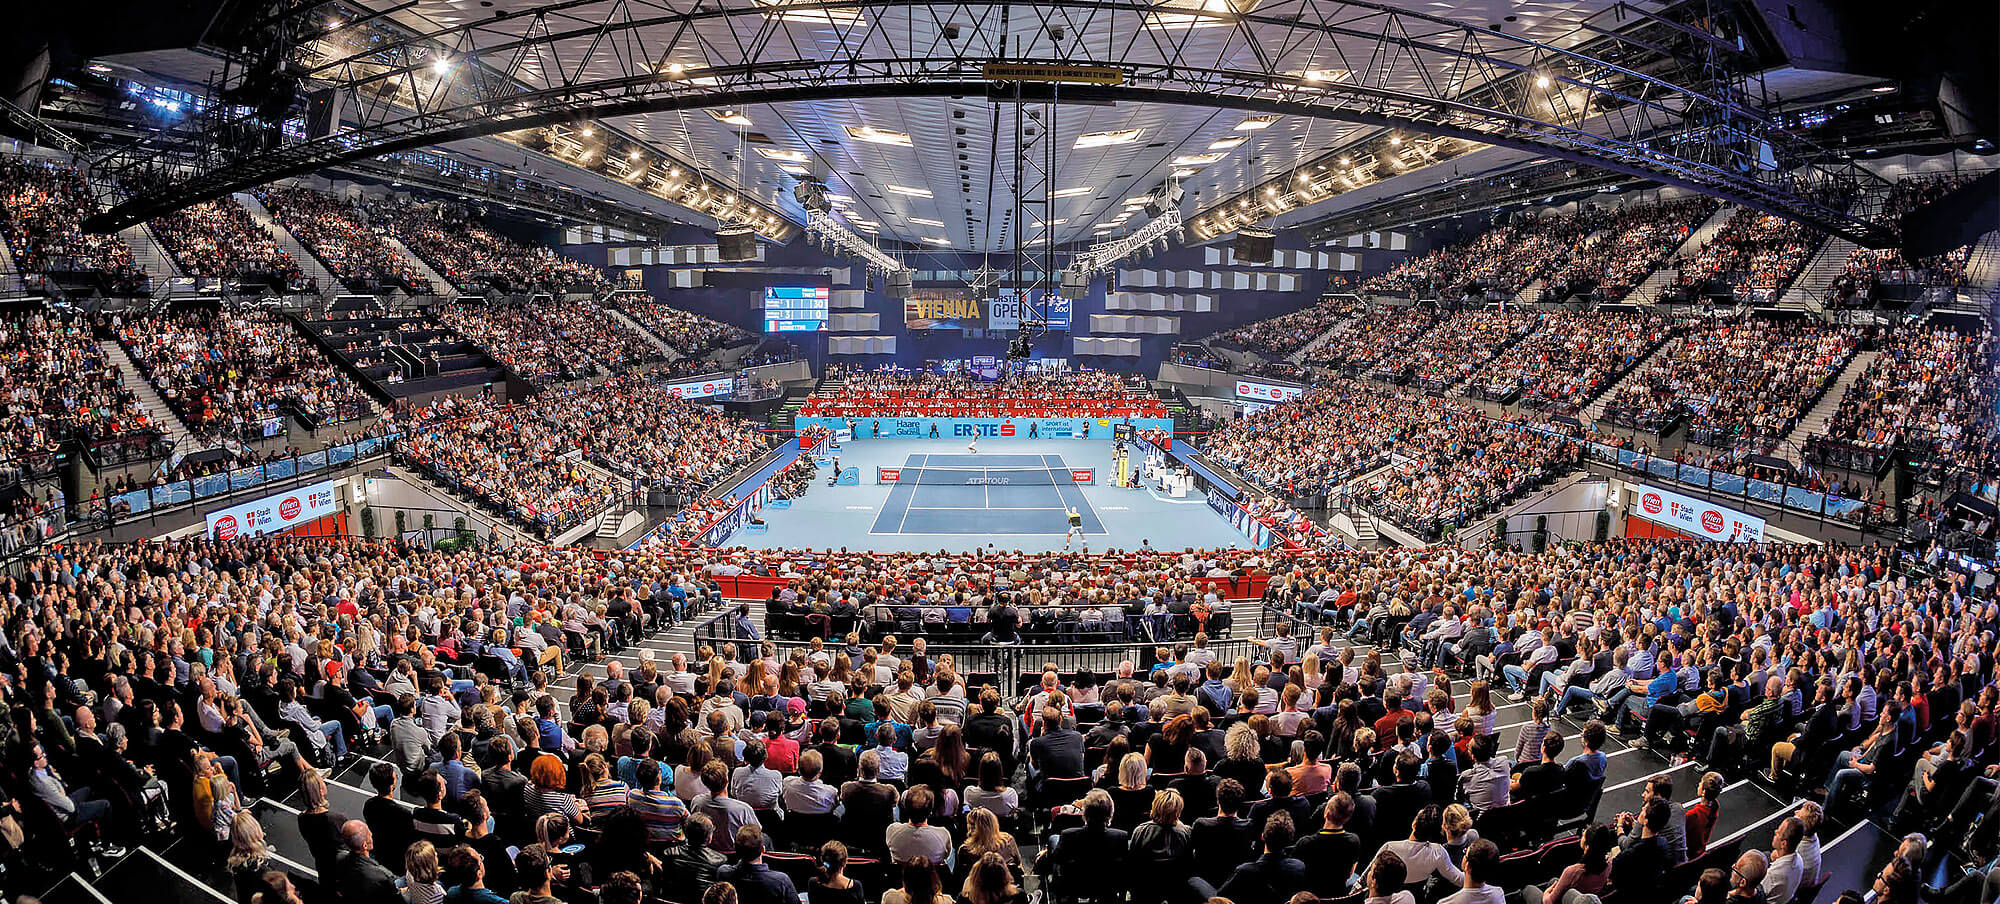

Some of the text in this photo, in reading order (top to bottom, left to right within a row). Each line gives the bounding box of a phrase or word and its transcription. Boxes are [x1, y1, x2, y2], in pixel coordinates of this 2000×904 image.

[915, 300, 981, 319] VIENNA
[993, 304, 1027, 318] OPEN
[896, 420, 921, 428] Haare
[954, 423, 998, 437] ERSTE
[986, 477, 1009, 485] TOUR
[317, 490, 331, 499] Stadt
[1644, 494, 1660, 505] Wien
[281, 501, 298, 511] Wien
[319, 497, 332, 507] Wien
[256, 507, 271, 517] Stadt
[1680, 504, 1694, 514] Stadt
[257, 516, 272, 526] Wien
[1680, 512, 1693, 522] Wien
[1704, 512, 1722, 524] Wien
[1744, 524, 1759, 535] Stadt
